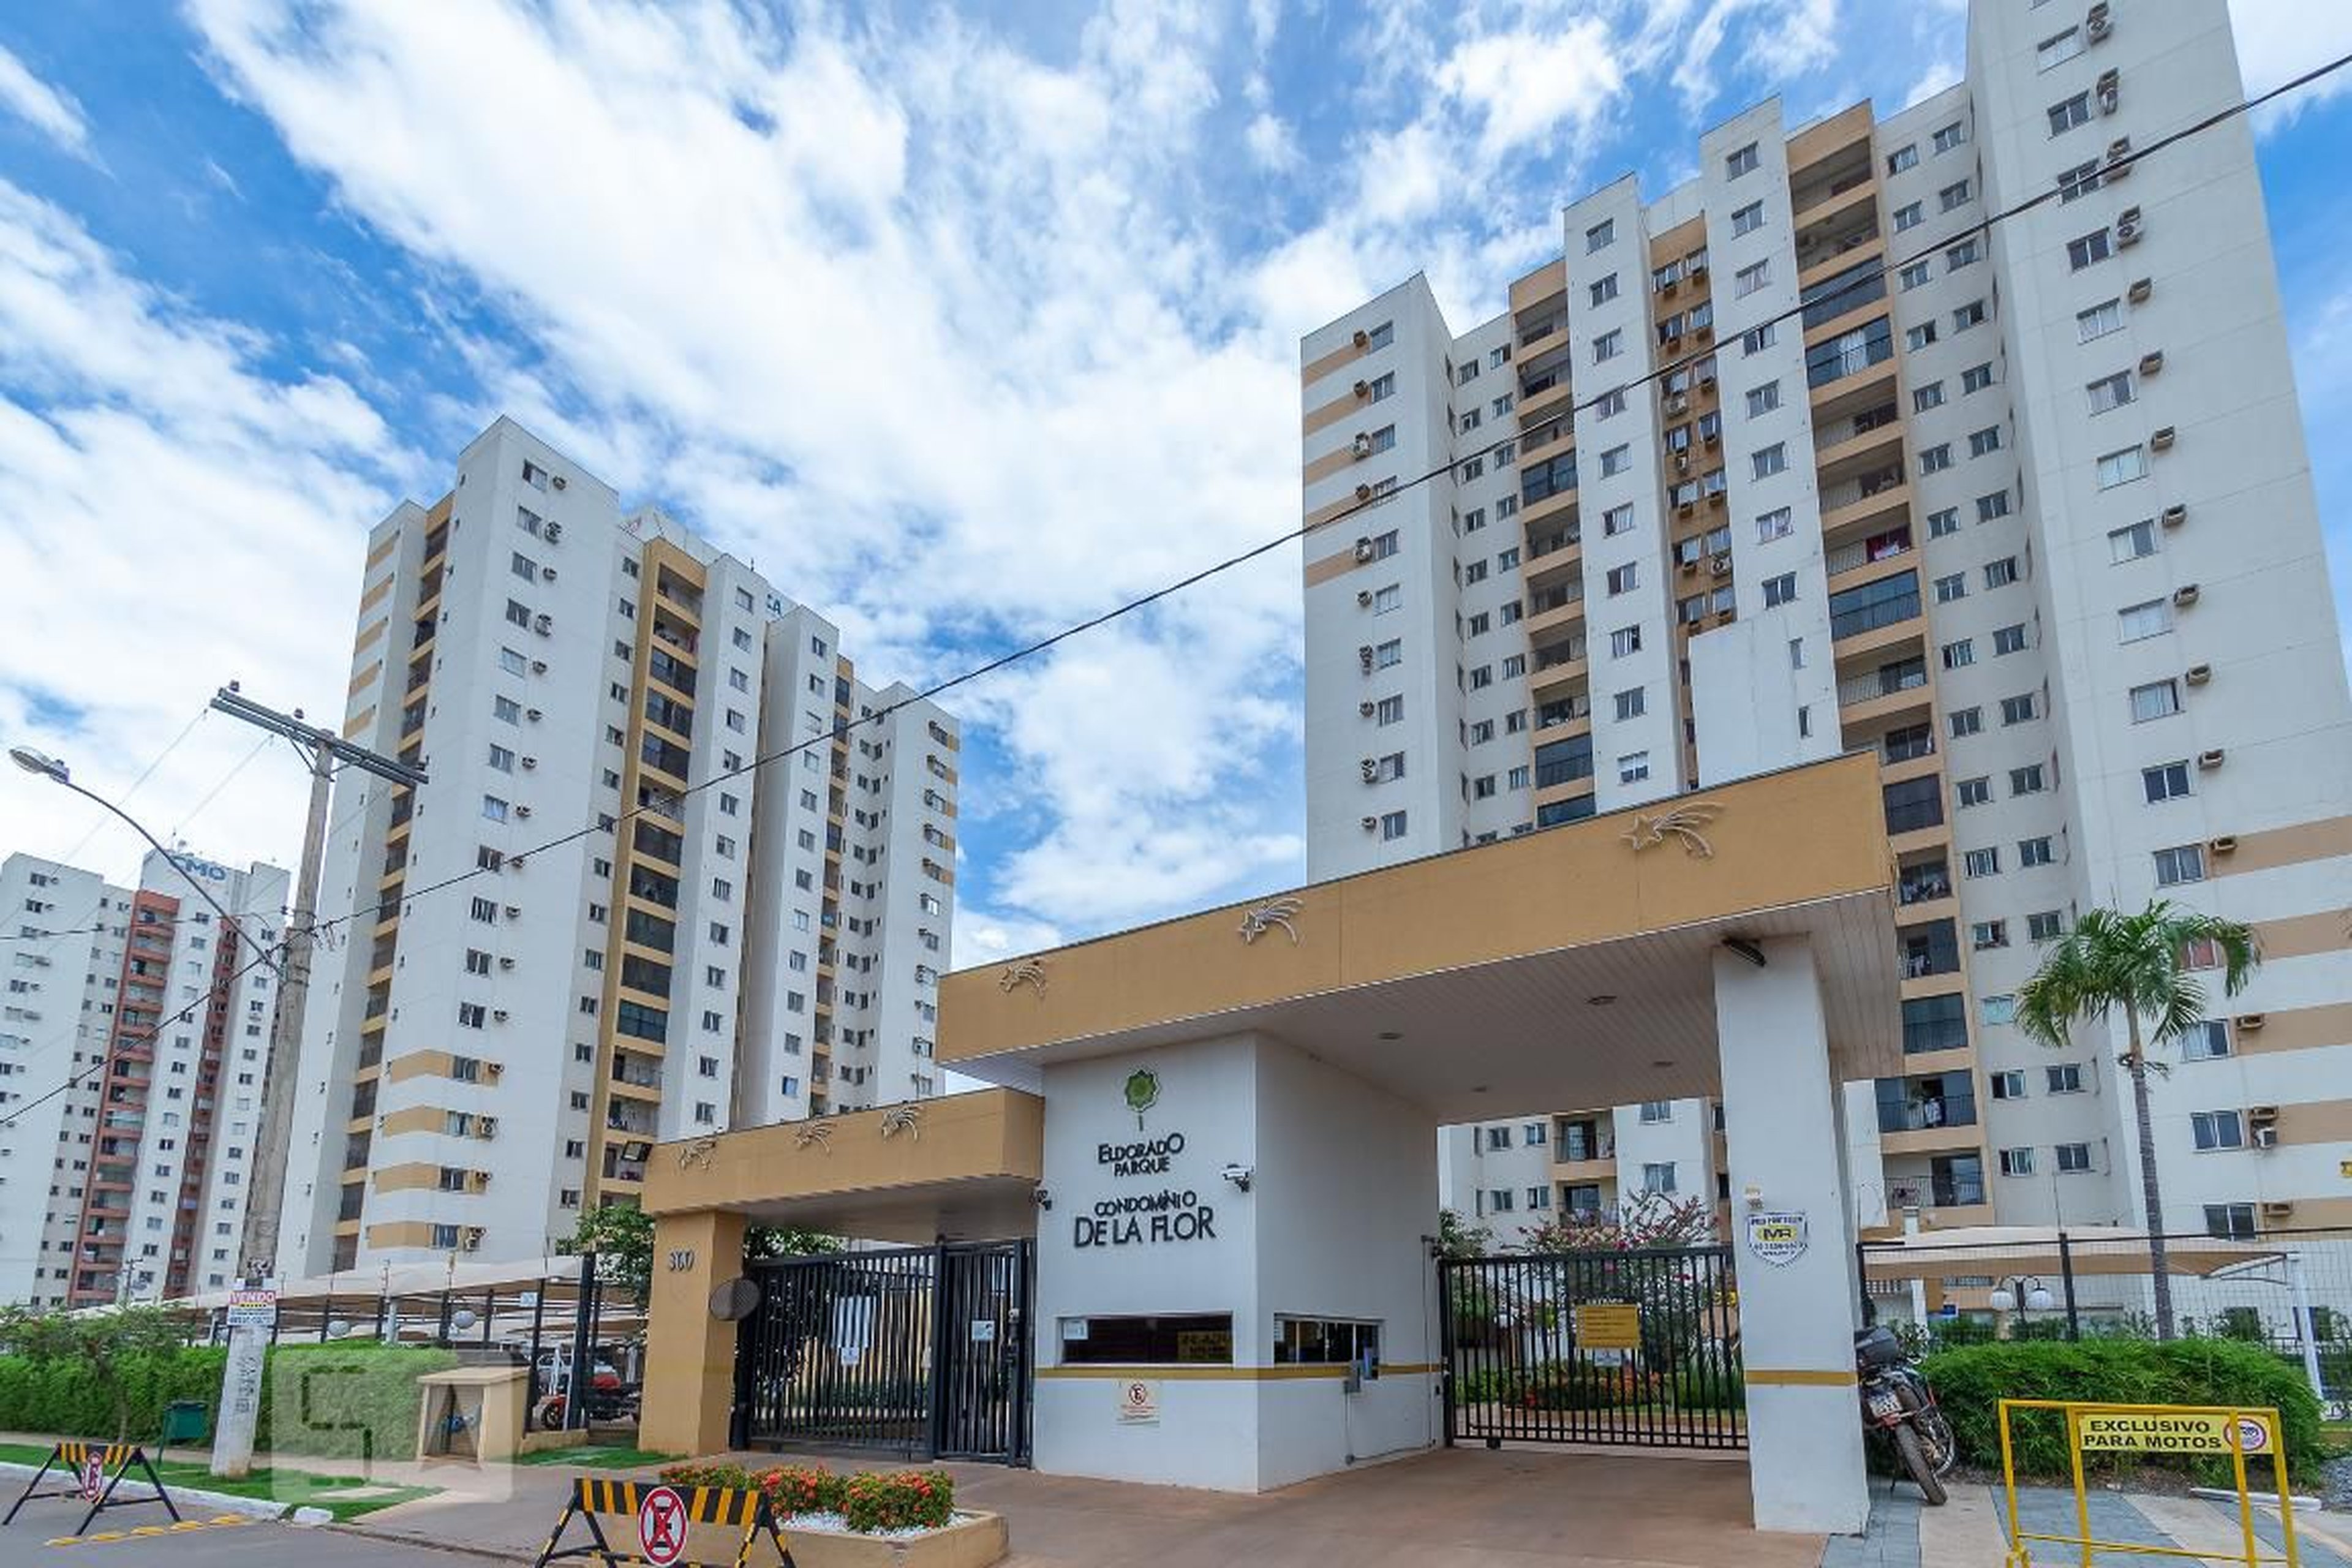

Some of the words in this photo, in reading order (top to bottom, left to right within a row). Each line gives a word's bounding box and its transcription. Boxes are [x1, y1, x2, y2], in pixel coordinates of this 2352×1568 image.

[1098, 1133, 1185, 1164] ELDORADO
[1114, 1158, 1170, 1177] PARQUE
[1074, 1216, 1108, 1248] DE
[1112, 1217, 1143, 1245] LA
[1150, 1206, 1216, 1243] FLOR
[229, 1292, 275, 1304] VENDO
[2090, 1420, 2210, 1433] EXCLUSIVO
[2084, 1434, 2138, 1447] PARA
[2144, 1436, 2222, 1449] MOTOS
